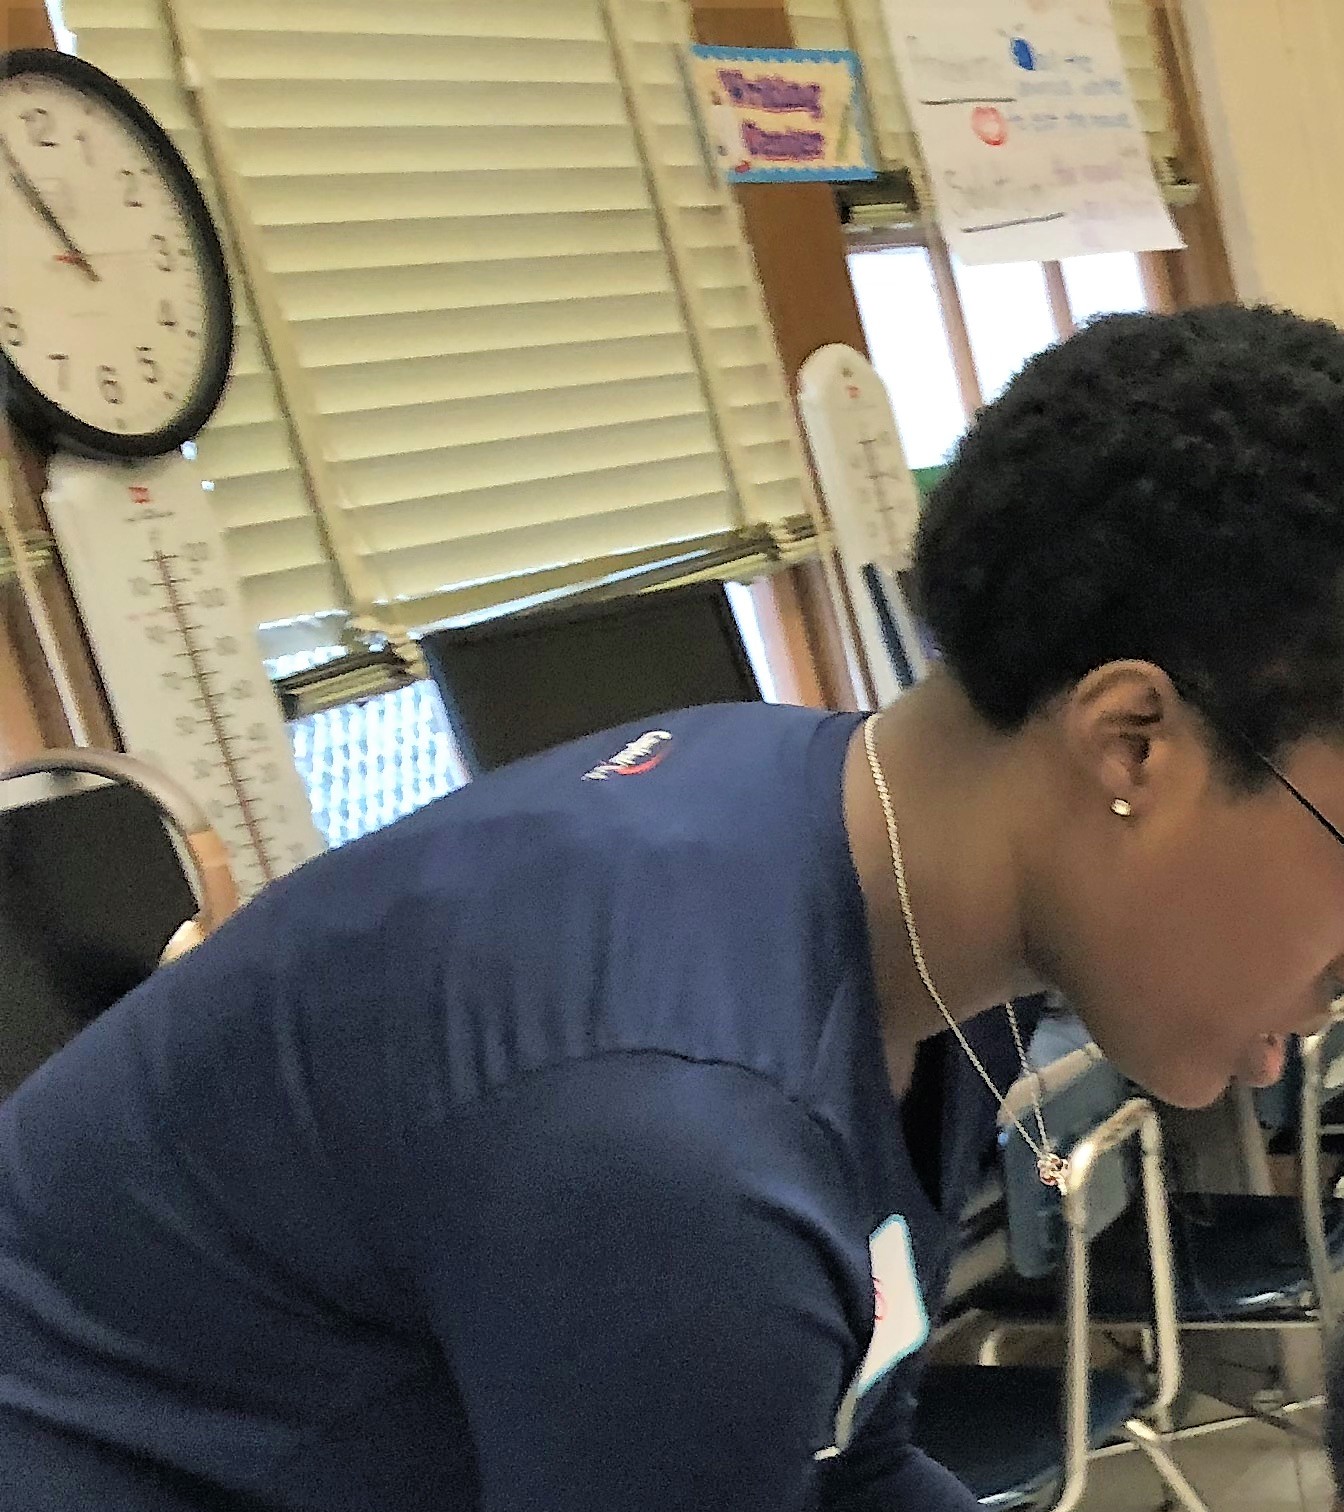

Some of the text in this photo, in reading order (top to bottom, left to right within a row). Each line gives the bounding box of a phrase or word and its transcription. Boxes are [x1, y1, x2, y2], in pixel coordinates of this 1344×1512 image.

[151, 233, 174, 273] 3
[48, 352, 70, 393] 7
[97, 363, 125, 404] 6
